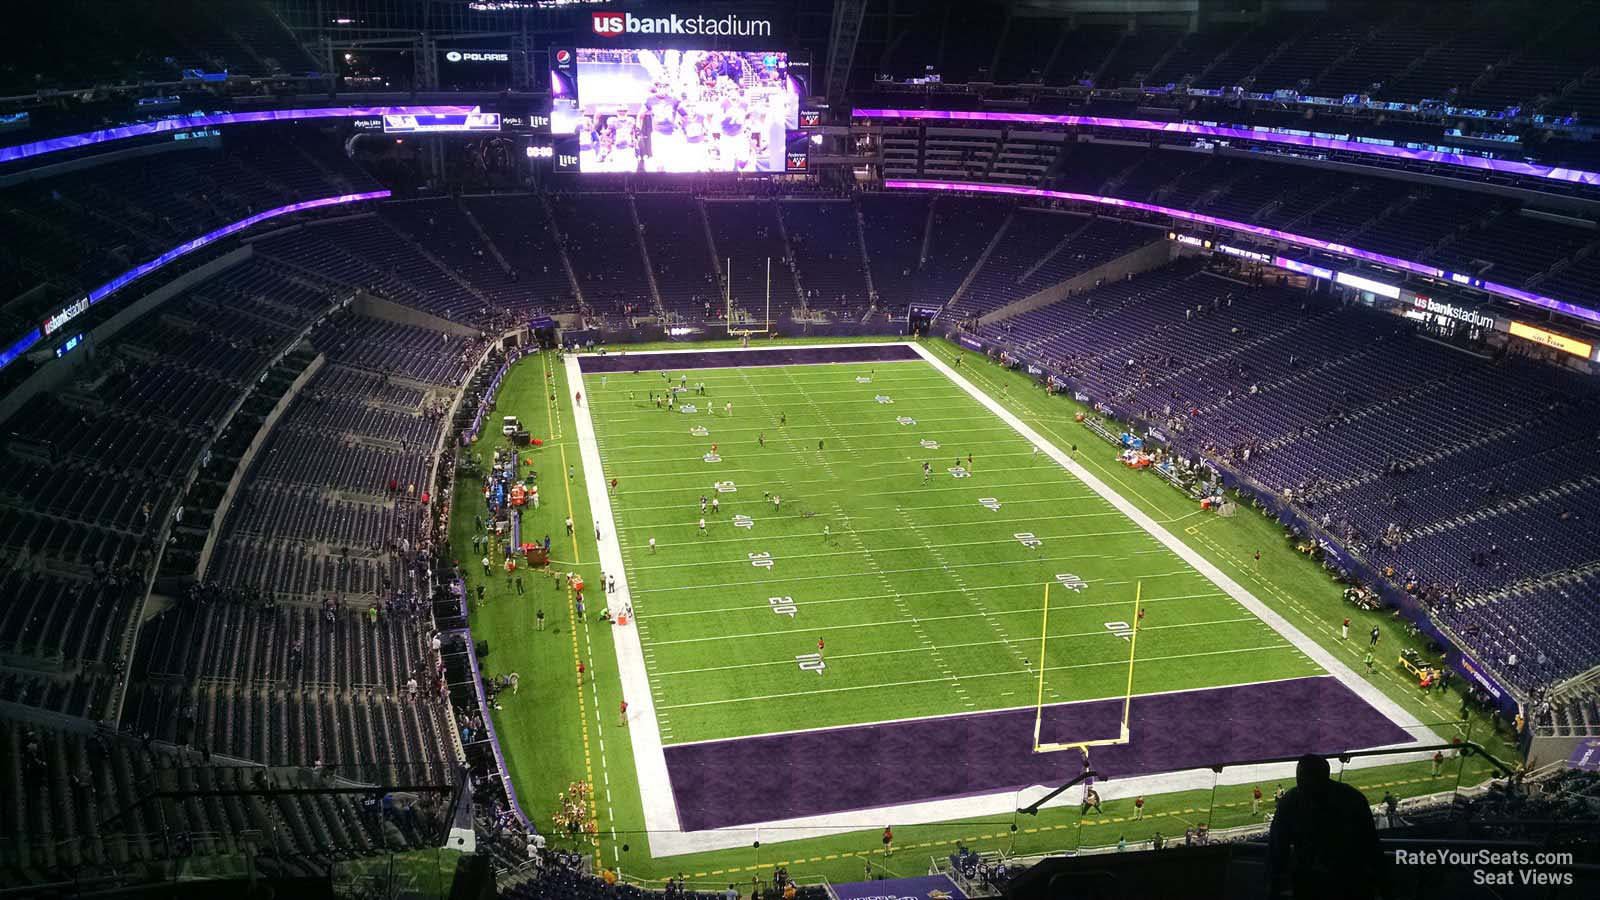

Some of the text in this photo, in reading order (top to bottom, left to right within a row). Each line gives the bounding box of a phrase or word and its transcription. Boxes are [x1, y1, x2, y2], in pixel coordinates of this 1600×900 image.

[463, 53, 508, 61] POLARIS
[530, 116, 549, 128] Lite
[559, 154, 578, 167] Lite
[1013, 532, 1043, 547] 30
[748, 552, 775, 567] 30
[768, 596, 798, 615] 20
[795, 653, 826, 671] 10
